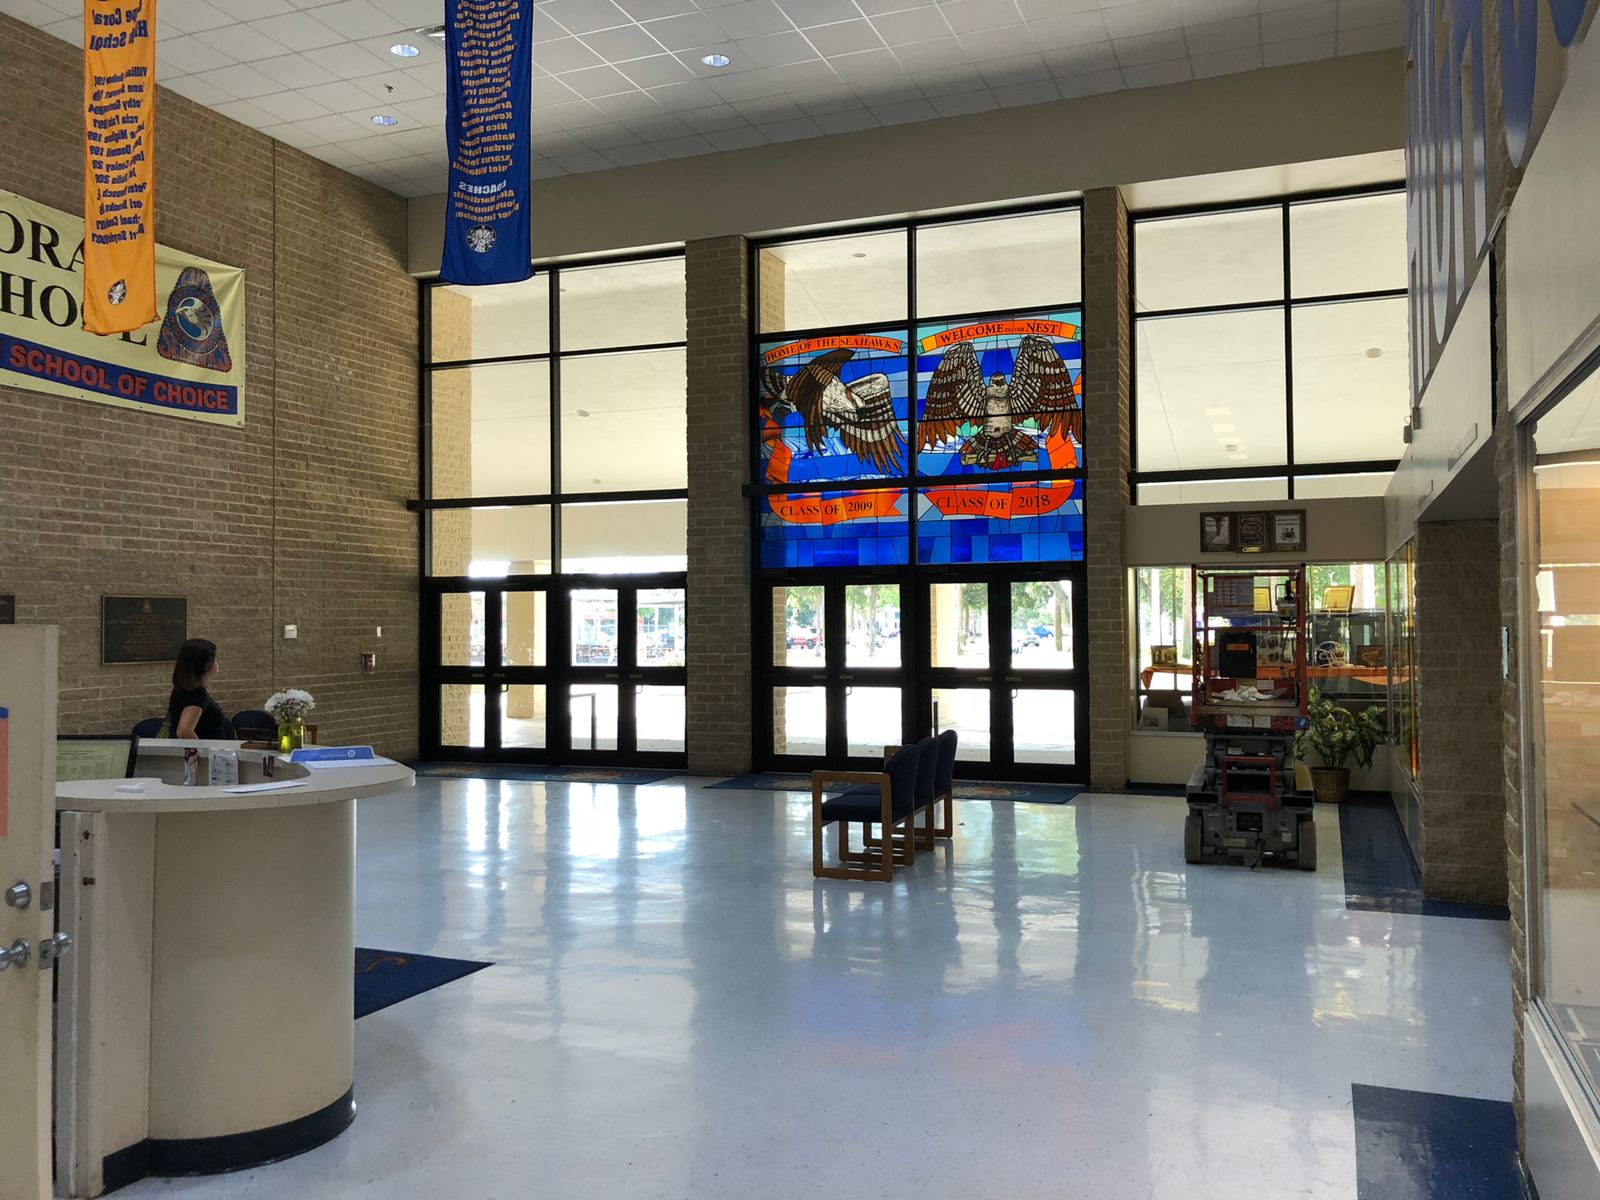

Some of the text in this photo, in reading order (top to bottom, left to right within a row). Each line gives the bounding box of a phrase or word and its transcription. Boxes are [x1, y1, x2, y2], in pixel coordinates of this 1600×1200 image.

[940, 324, 1004, 343] WELCOME
[1026, 321, 1059, 334] NEST
[766, 337, 900, 362] HOME OF THE SEAHAWKS
[10, 344, 229, 410] SCHOOL OF CHOICE
[780, 501, 873, 516] CLASS OF 2009
[936, 494, 1050, 510] CLASS OF 2018
